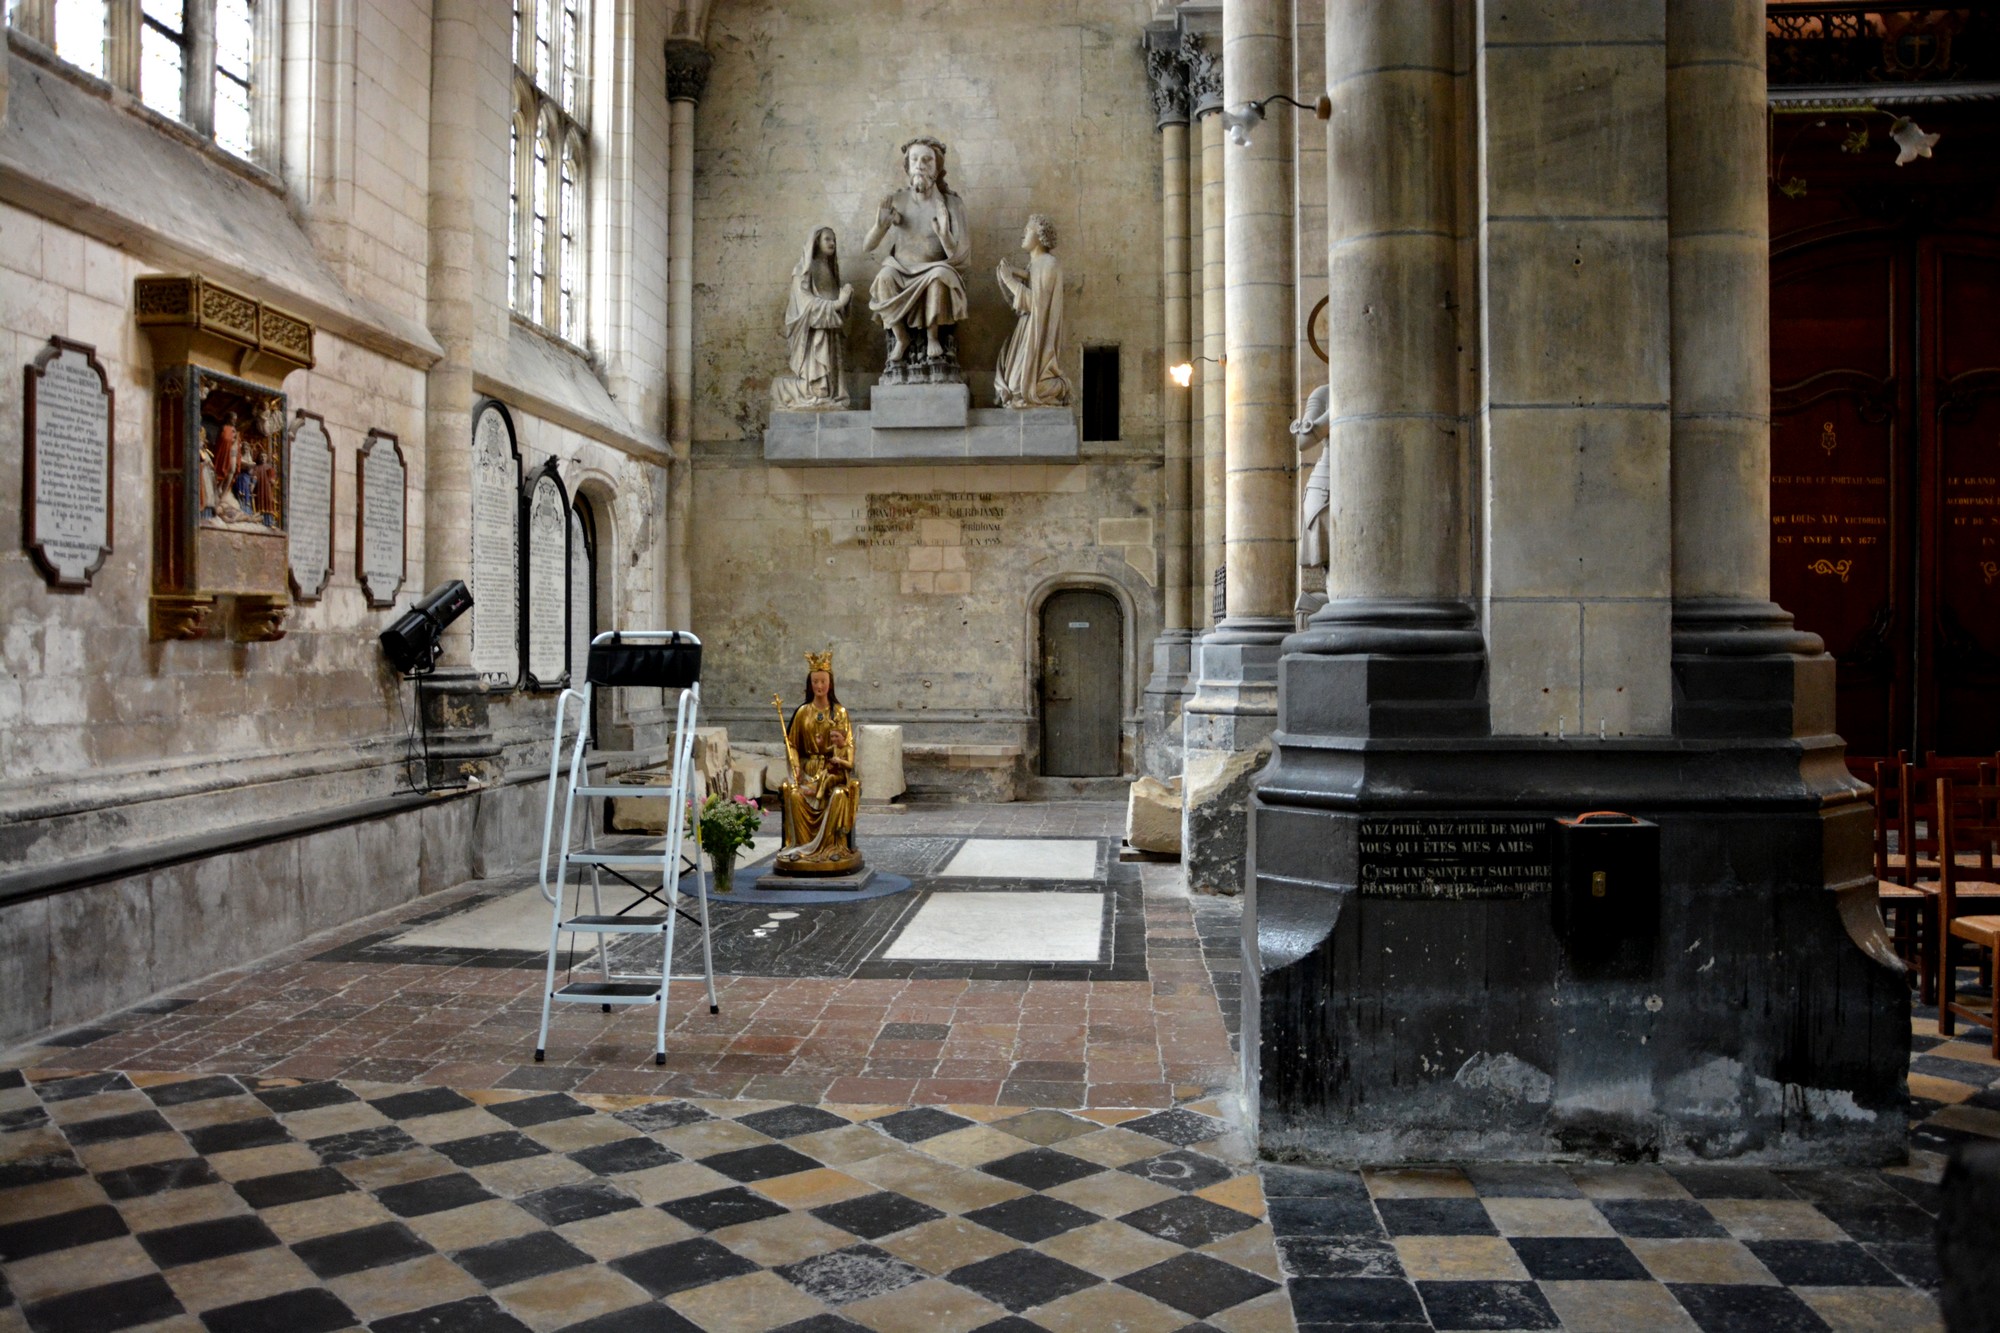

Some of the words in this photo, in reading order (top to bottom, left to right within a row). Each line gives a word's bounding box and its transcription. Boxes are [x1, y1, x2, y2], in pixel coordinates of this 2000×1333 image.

[1796, 476, 1812, 484] PAR
[1964, 477, 1996, 485] GRAND
[1773, 516, 1786, 525] QUE
[1791, 514, 1816, 524] LOUIS
[1822, 514, 1838, 524] XIV
[1360, 824, 1389, 835] AYEZ
[1491, 823, 1507, 835] DE
[1359, 842, 1392, 854] VOUS
[1396, 842, 1418, 857] QUI
[1461, 841, 1491, 853] MES
[1496, 841, 1534, 853] AMIS
[1403, 867, 1426, 877] UNE
[1428, 866, 1467, 877] SAINTE
[1470, 866, 1484, 876] ET
[1489, 865, 1551, 877] SALUTAIRE
[1362, 882, 1418, 895] PRATIQUE
